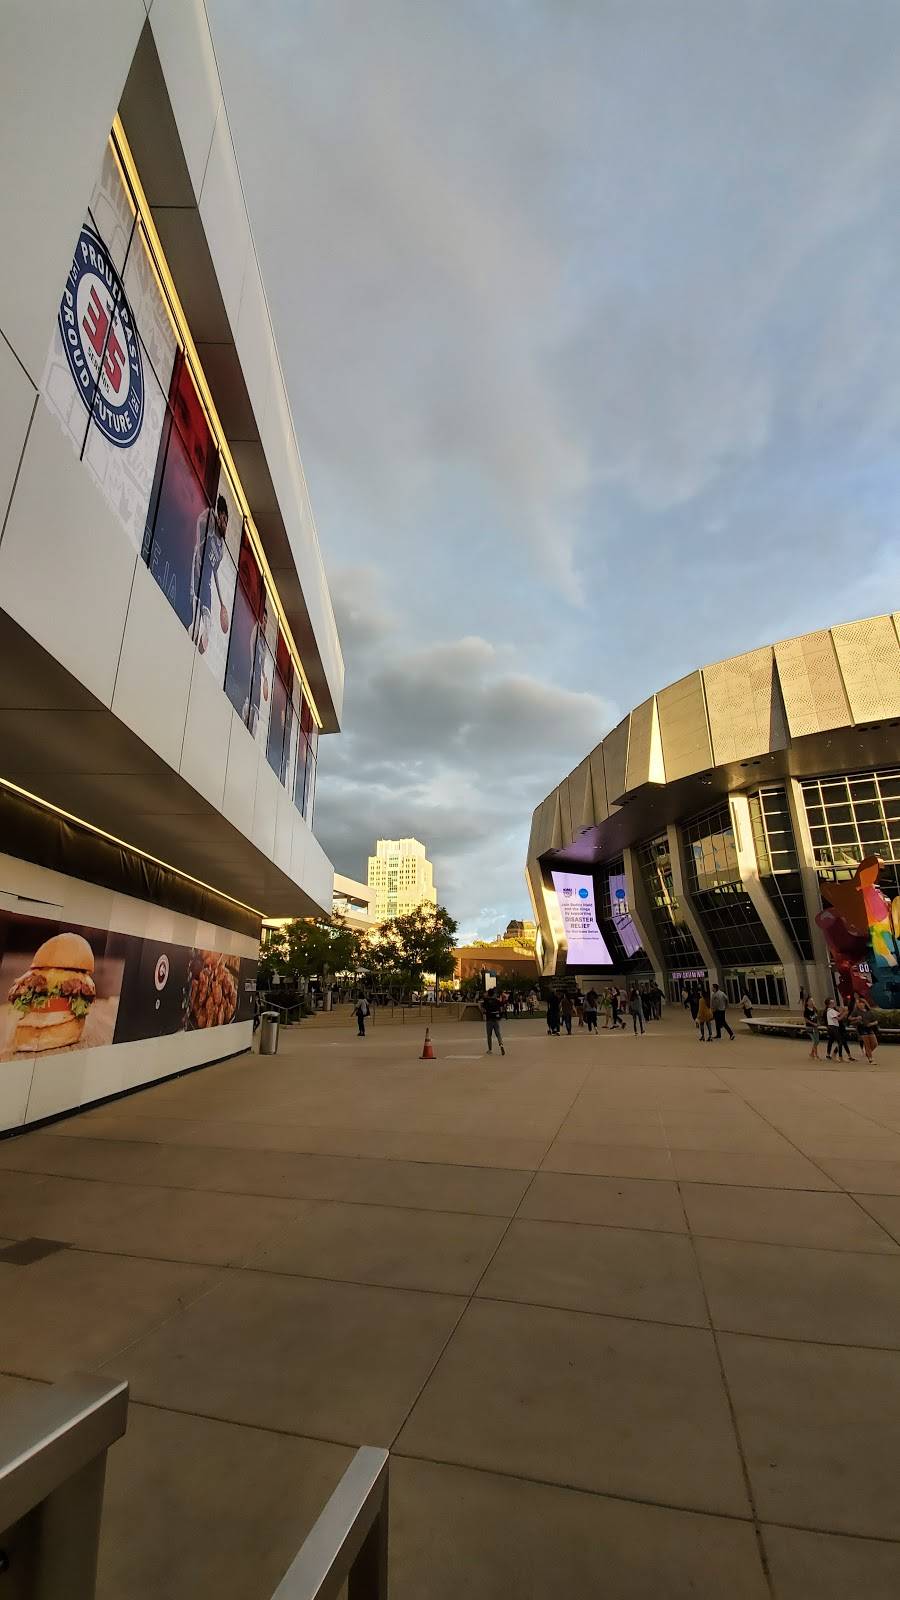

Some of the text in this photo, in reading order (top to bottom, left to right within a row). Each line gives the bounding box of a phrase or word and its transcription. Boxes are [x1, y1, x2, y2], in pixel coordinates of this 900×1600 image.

[62, 289, 89, 388] PROUD
[80, 241, 140, 376] PROUD PAST
[83, 284, 125, 394] 35
[94, 394, 132, 433] FUTURE
